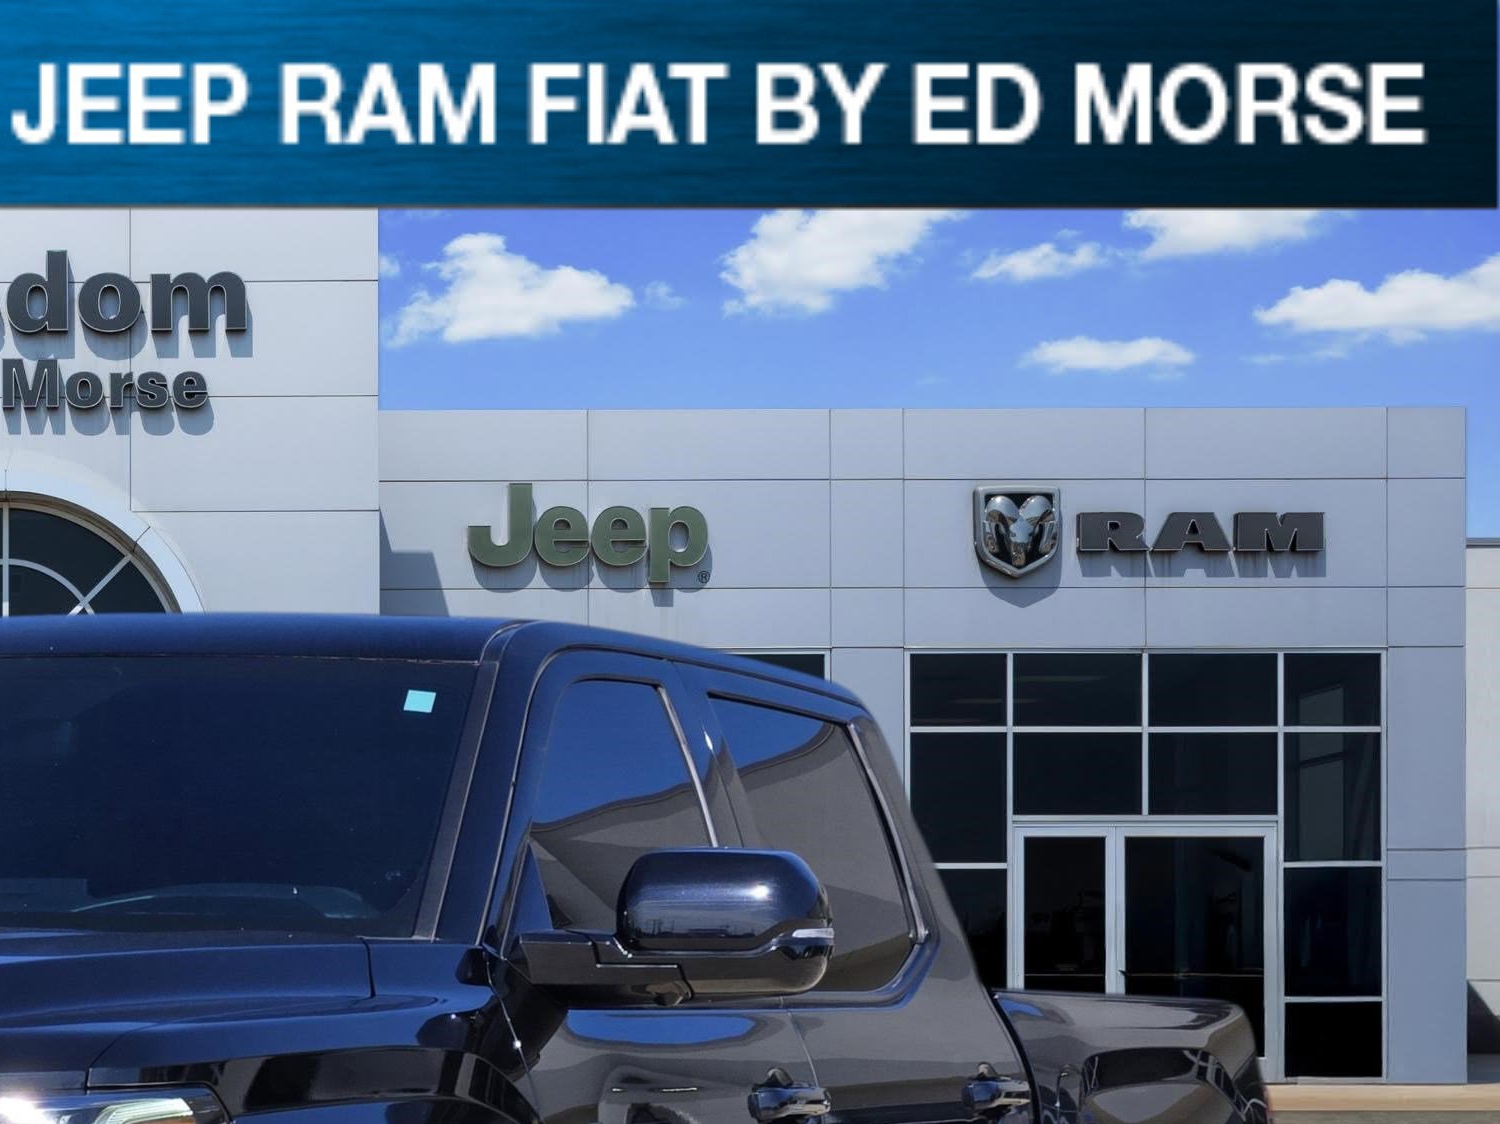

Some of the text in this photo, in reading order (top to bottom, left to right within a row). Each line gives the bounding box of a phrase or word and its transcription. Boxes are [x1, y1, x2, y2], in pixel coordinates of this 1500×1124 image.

[2, 358, 209, 409] Morse
[466, 483, 709, 584] Jeep
[1076, 511, 1326, 552] RAM
